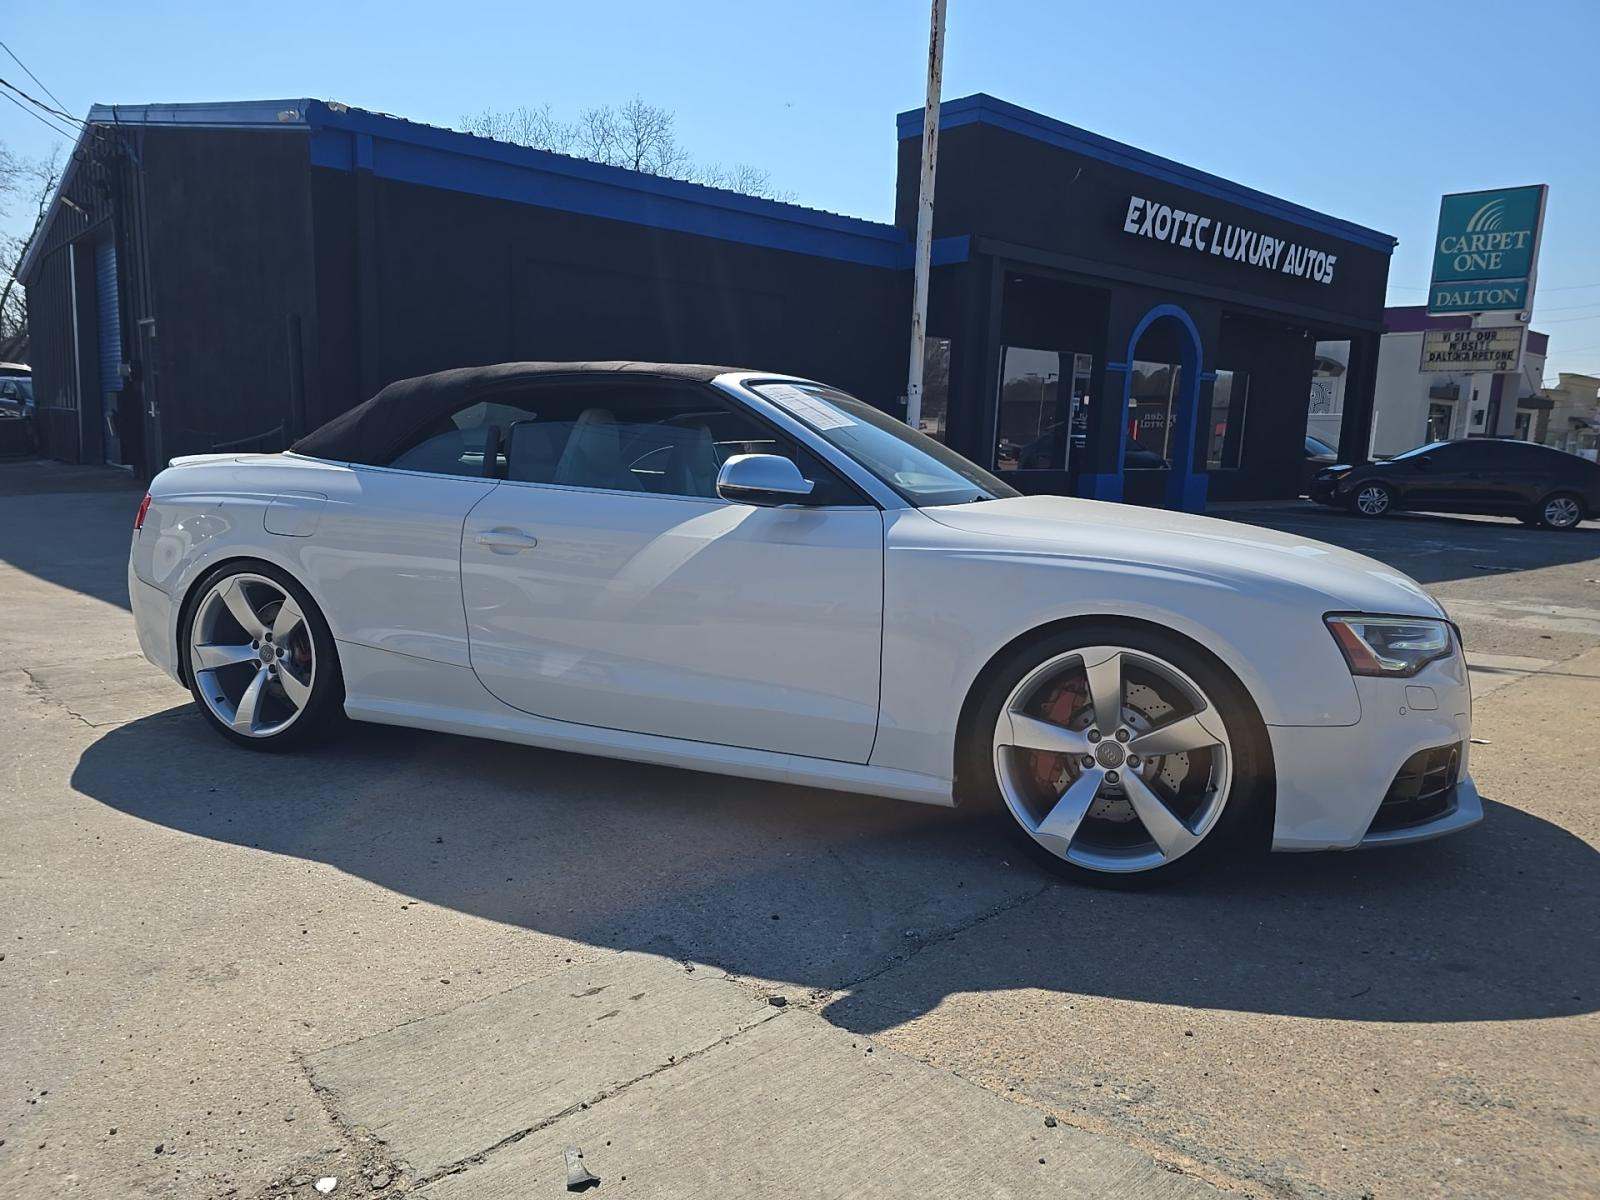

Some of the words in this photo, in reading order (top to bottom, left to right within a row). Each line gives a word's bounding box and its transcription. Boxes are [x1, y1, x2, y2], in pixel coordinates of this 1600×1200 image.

[1124, 195, 1211, 251] EXOTIC
[1210, 222, 1286, 270] LUXURY
[1282, 243, 1337, 284] AUTOS
[1440, 231, 1530, 254] CARPET
[1453, 252, 1502, 271] ONE
[1436, 288, 1520, 306] DALTON
[1476, 331, 1497, 340] OUR
